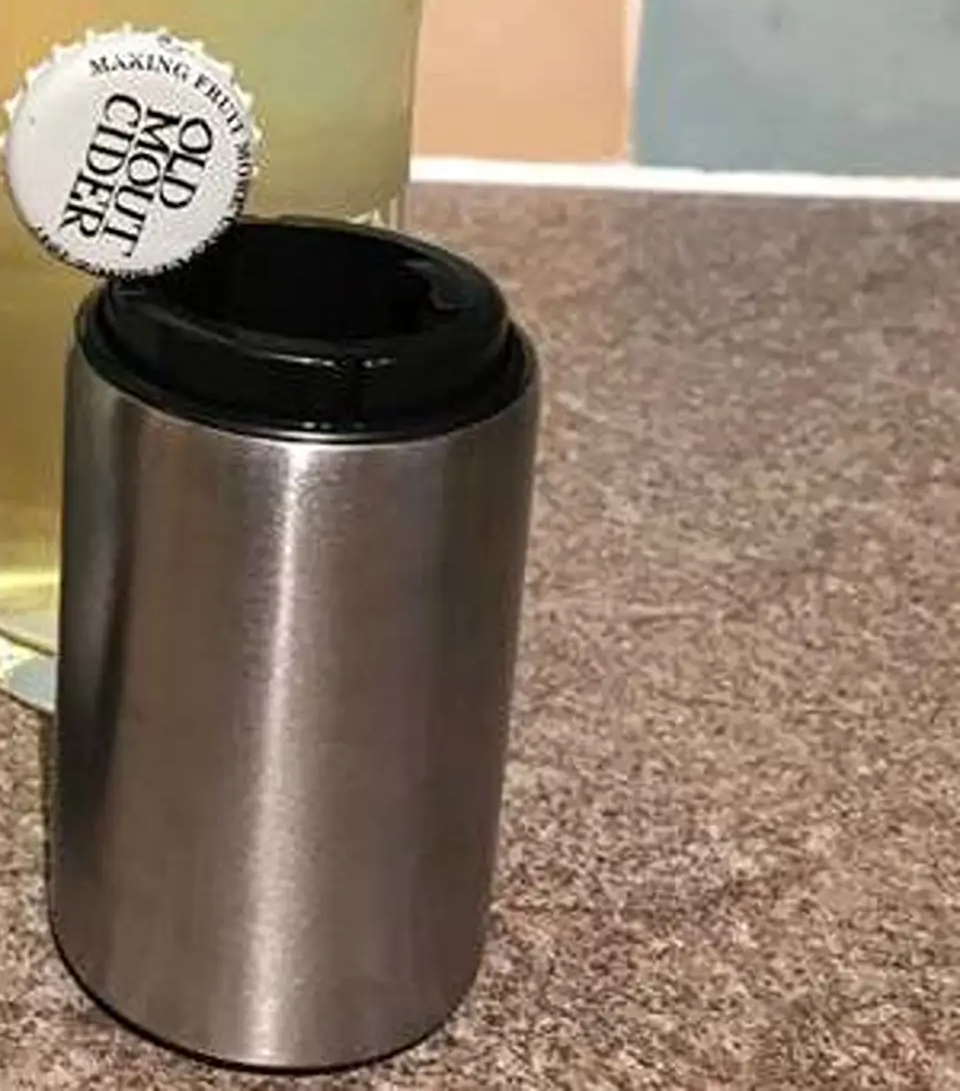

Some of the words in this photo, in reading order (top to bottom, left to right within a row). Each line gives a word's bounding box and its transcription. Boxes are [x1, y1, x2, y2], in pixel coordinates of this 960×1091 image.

[90, 52, 190, 82] MAKING
[194, 74, 245, 134] FRUIT
[59, 92, 142, 239] CIDER
[104, 107, 183, 258] MOUT
[160, 117, 214, 209] OLD
